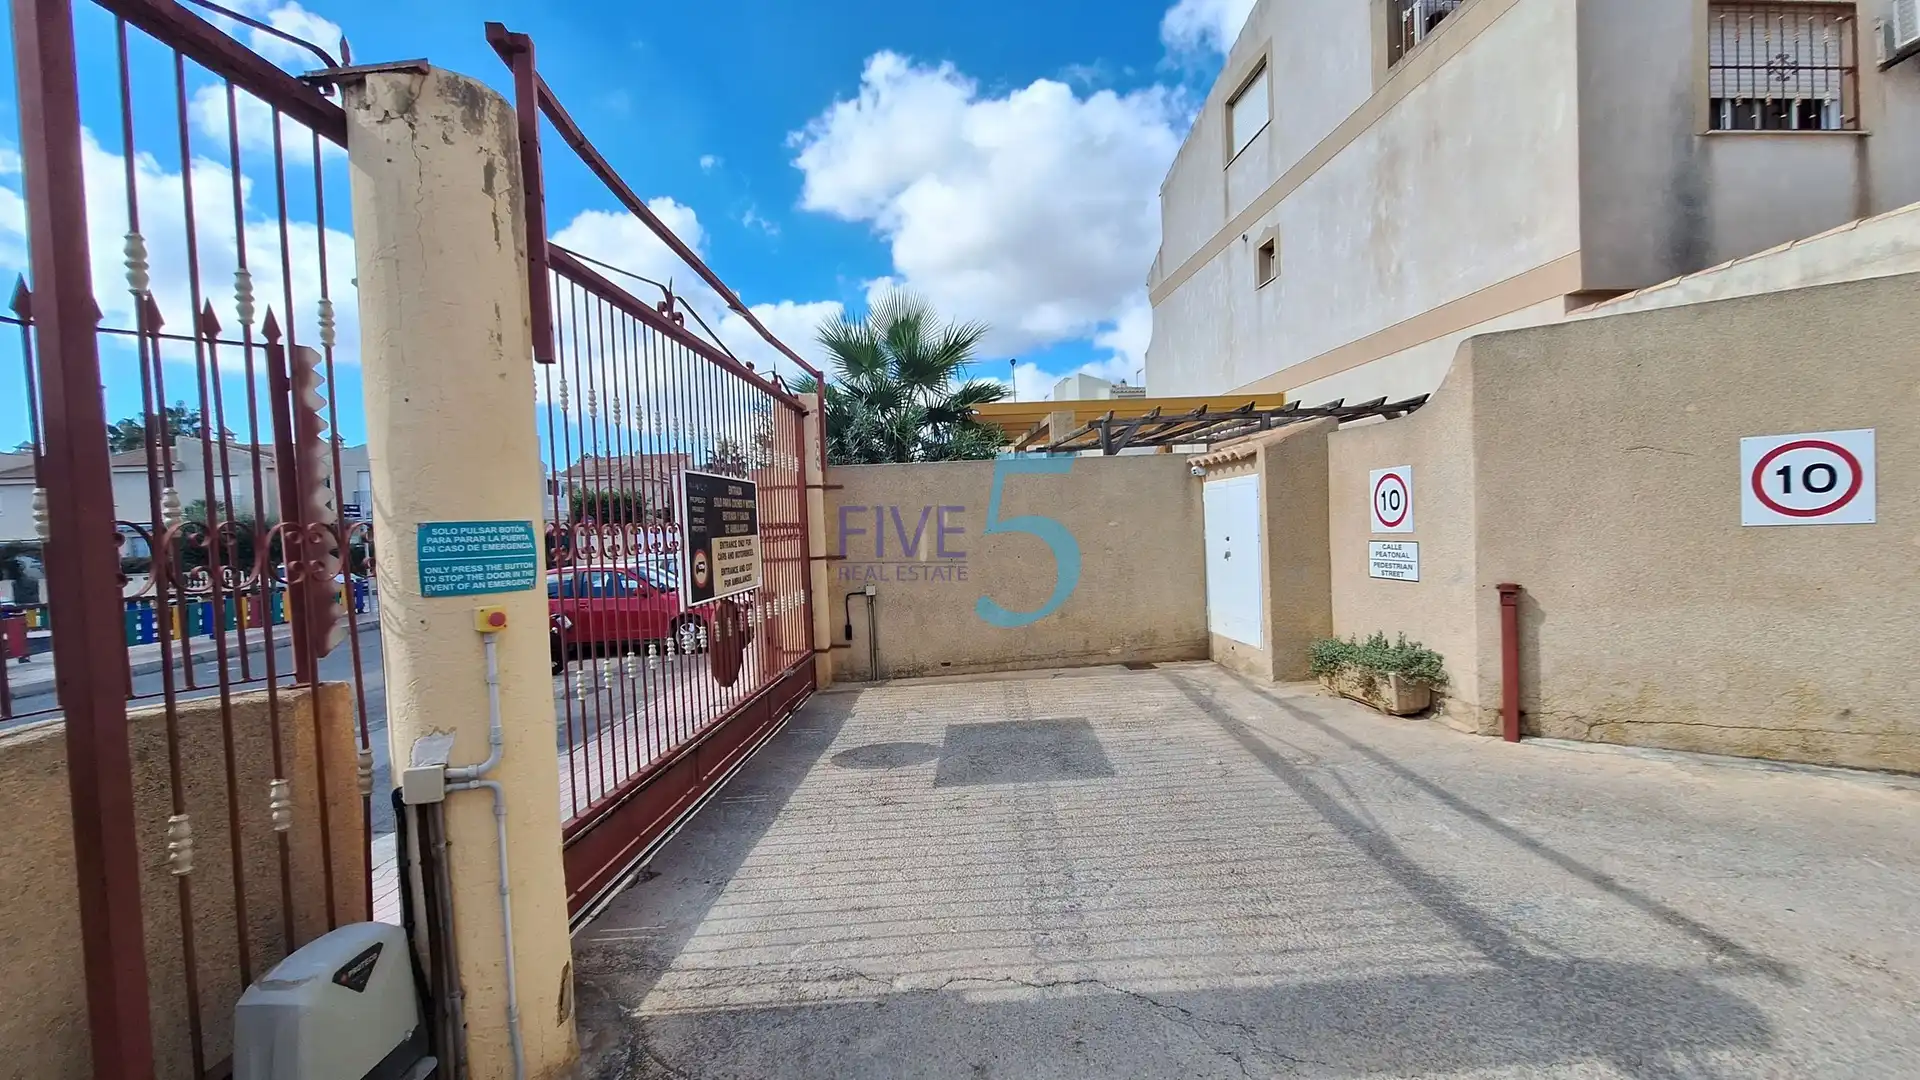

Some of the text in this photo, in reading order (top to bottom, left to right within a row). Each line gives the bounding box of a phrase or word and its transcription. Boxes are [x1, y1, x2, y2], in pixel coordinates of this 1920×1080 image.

[1776, 463, 1837, 494] 10
[1381, 490, 1400, 511] 10
[460, 526, 497, 535] PULSAR
[453, 535, 486, 543] PARAR
[437, 544, 465, 553] CASO
[482, 542, 534, 551] EMERGENCIA
[719, 540, 738, 550] ENTRANCE
[717, 552, 727, 561] CARS
[727, 551, 735, 560] AND
[1375, 551, 1410, 559] PEATONAL
[424, 562, 534, 574] ONLY PRESS THE BUTTON
[1373, 561, 1413, 570] PEDESTRIAN
[424, 575, 436, 583] TO
[438, 574, 464, 582] STOP
[465, 573, 484, 581] THE
[486, 571, 512, 580] DOOR
[521, 569, 535, 577] THE
[720, 566, 739, 576] ENTRANCE
[424, 578, 534, 592] EVENT OF AN EMERGENCY
[723, 578, 731, 588] FOR
